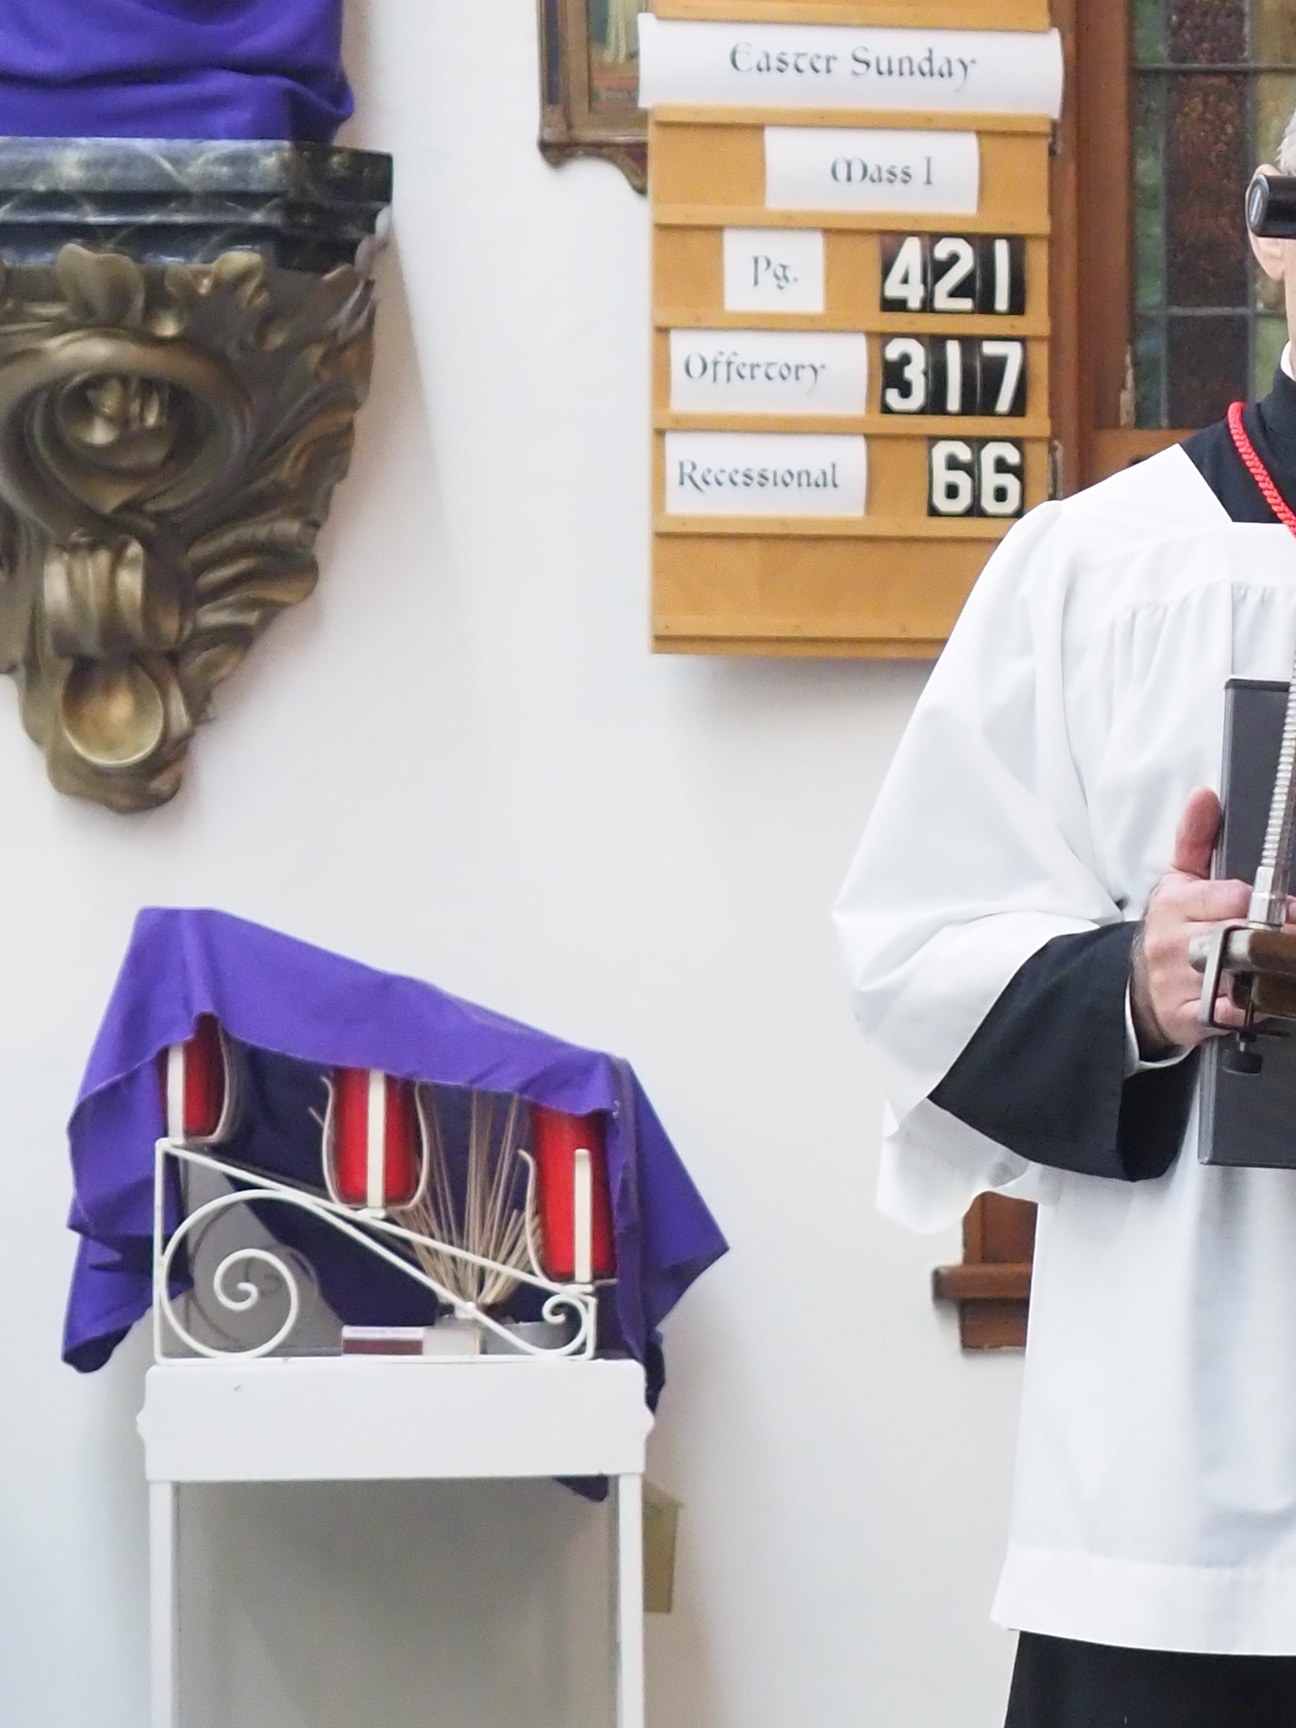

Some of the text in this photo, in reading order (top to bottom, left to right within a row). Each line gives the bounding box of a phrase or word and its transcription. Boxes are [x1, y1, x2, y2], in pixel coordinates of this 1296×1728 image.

[729, 41, 977, 91] Easter Sunday
[830, 155, 934, 186] Mass I
[751, 236, 1010, 312] Pg. 421
[683, 337, 1024, 414] Offertory 317
[678, 439, 1022, 516] Recessional 66
